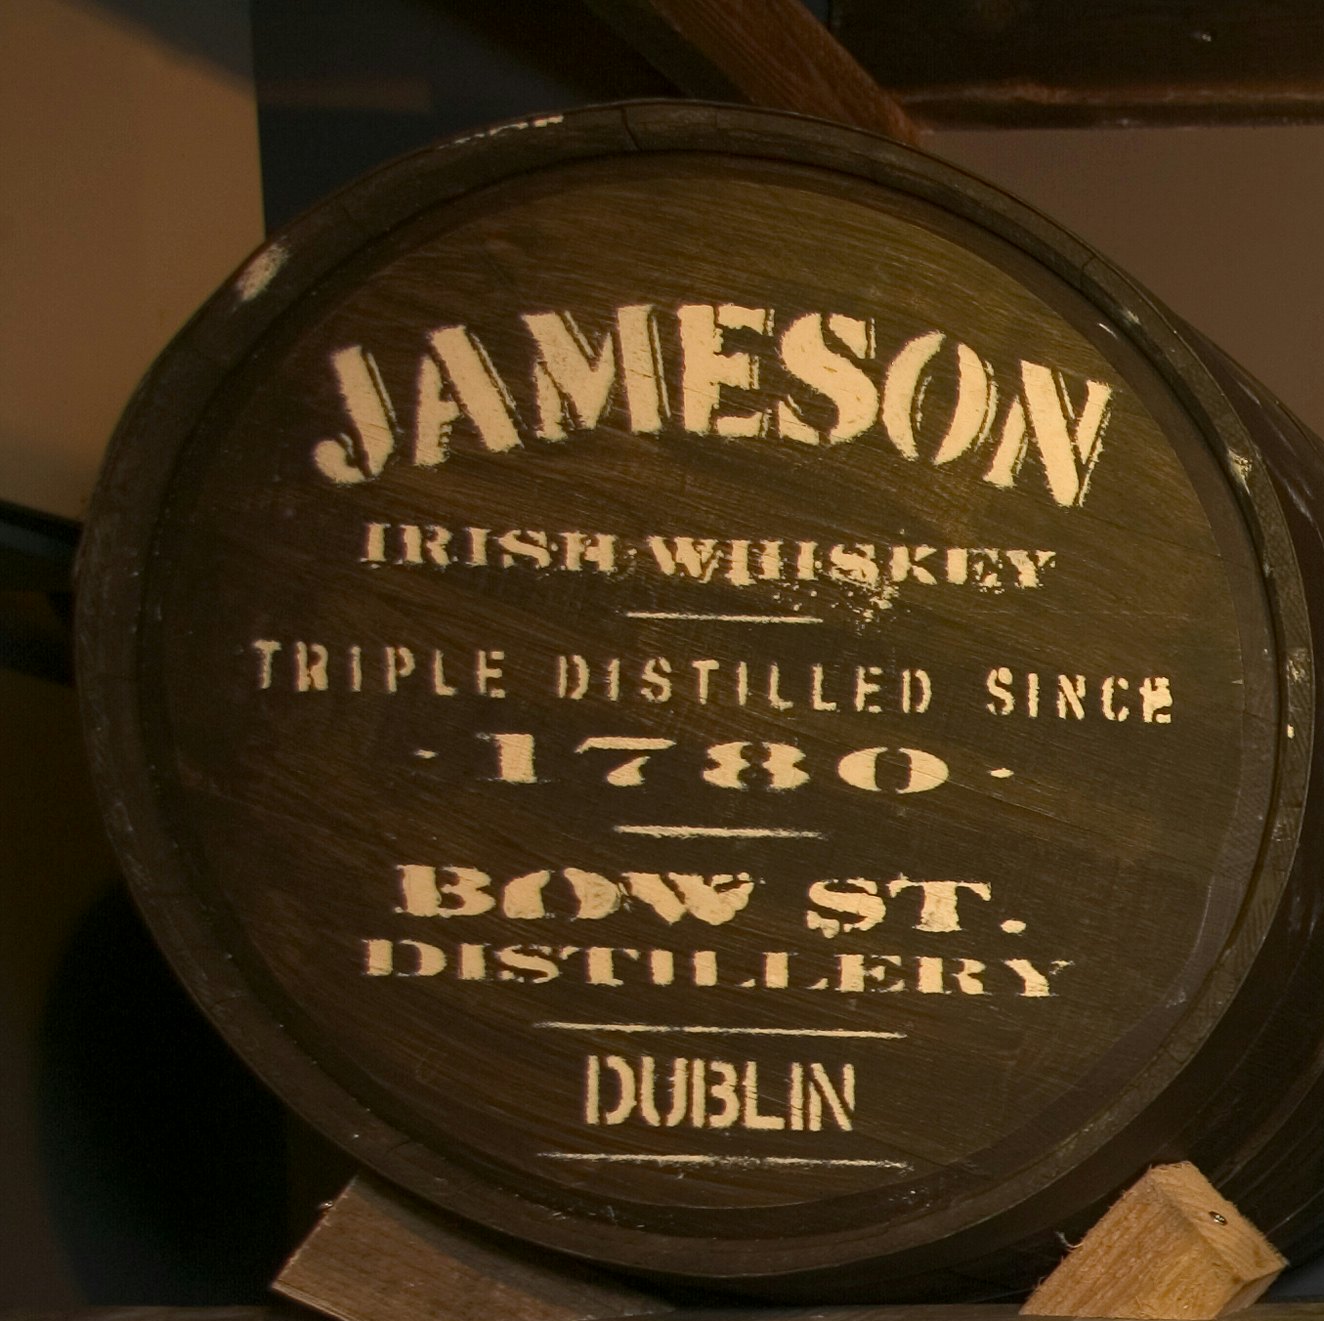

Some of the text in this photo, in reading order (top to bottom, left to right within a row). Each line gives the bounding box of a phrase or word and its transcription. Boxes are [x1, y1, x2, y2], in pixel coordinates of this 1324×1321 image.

[312, 302, 1113, 509] JAMESON
[358, 520, 1058, 592] IRISH WHISKEY
[252, 637, 1177, 723] TRIPLE DISTILLED SINCE
[393, 862, 1029, 935] BOW ST.
[360, 936, 1075, 999] DISTILLERY
[583, 1053, 857, 1133] DUBLIN
